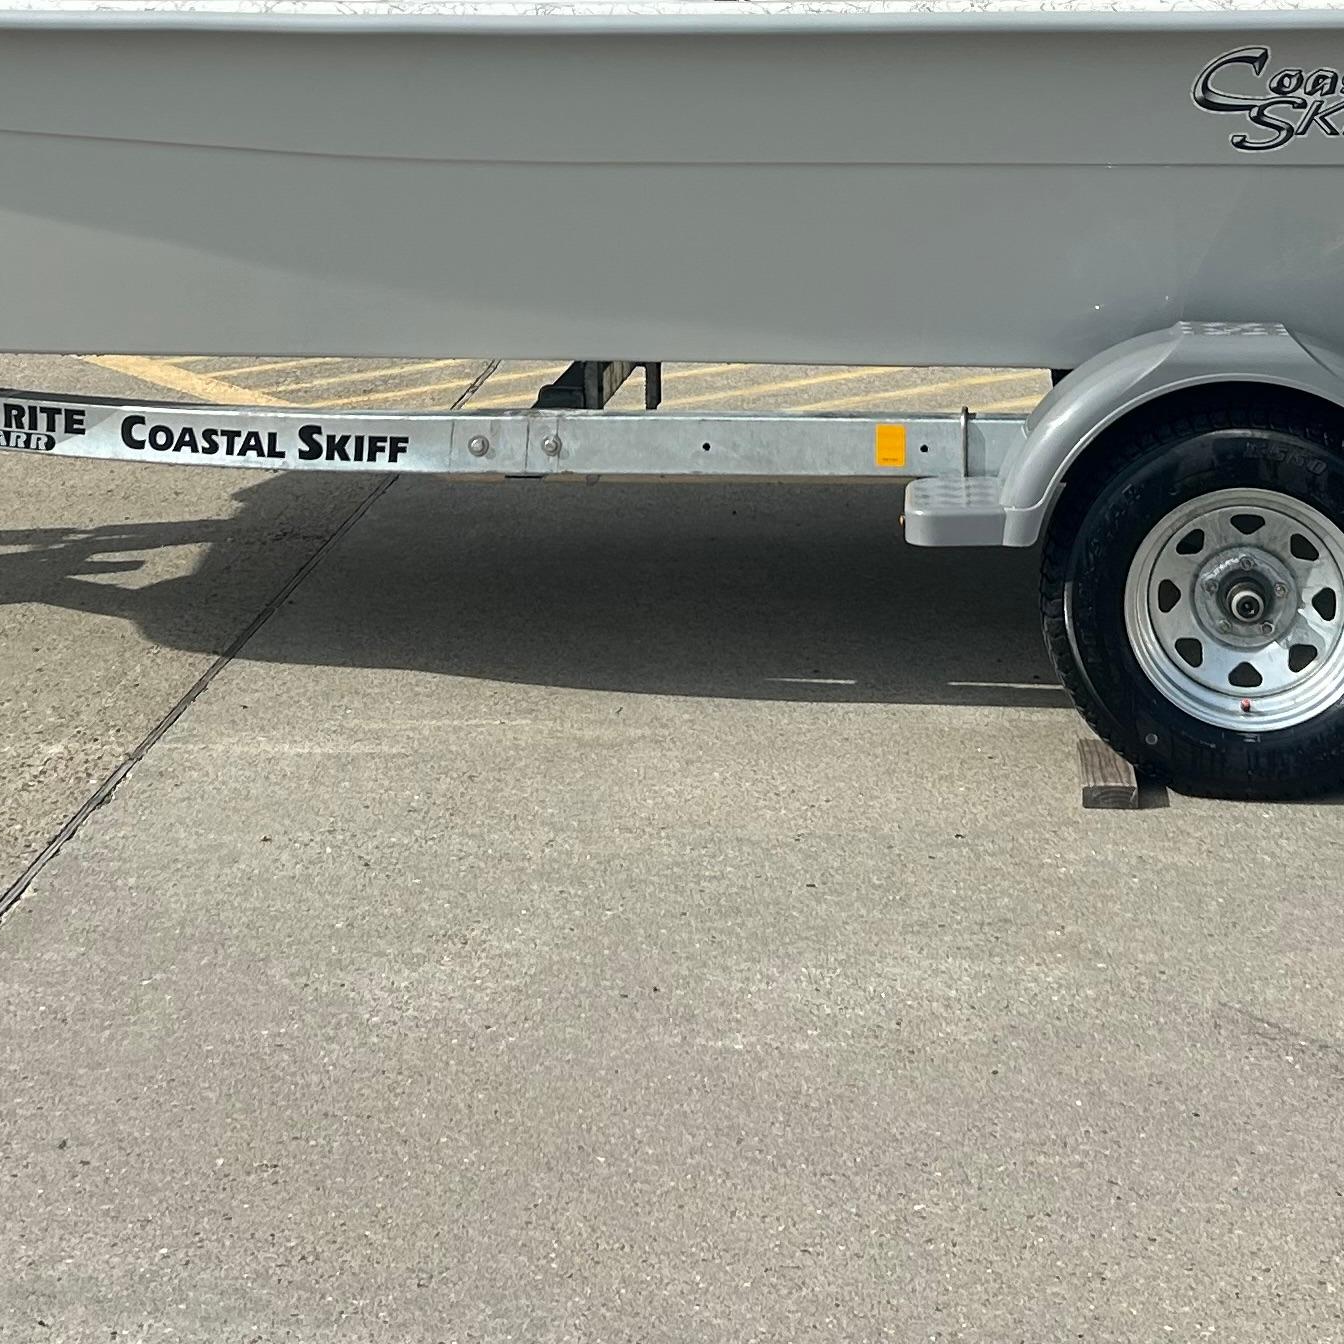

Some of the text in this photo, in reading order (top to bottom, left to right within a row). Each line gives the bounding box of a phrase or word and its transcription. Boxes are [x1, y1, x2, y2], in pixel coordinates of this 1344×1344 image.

[3, 403, 86, 435] RITE
[120, 415, 410, 463] COASTAL SKIFF
